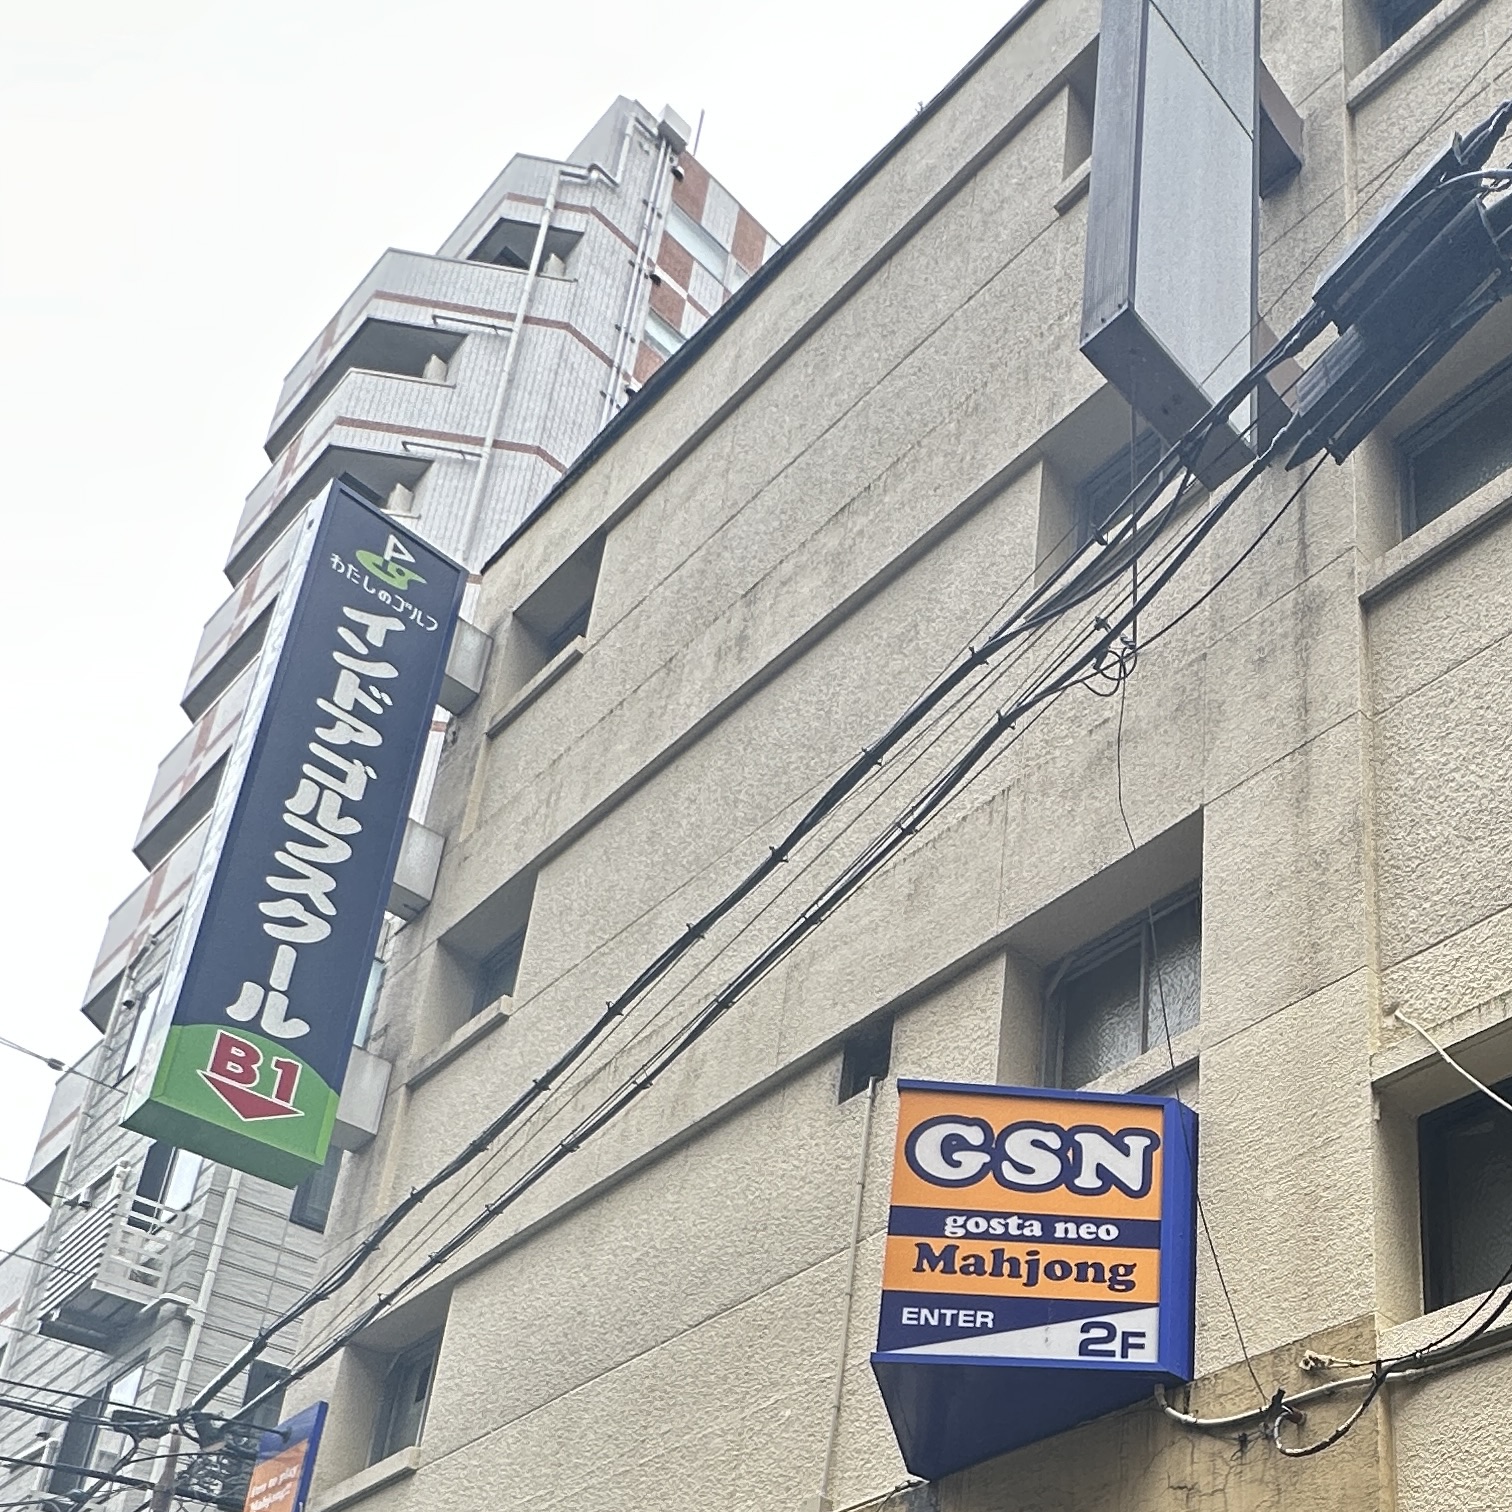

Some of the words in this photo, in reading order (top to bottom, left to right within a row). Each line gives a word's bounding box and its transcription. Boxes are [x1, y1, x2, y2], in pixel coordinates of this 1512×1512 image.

[330, 554, 439, 631] わたしのゴルフ
[226, 605, 406, 1039] インドアゴルフスクール
[206, 1029, 302, 1106] B1
[908, 1117, 1158, 1197] GSN
[944, 1215, 1042, 1238] gosta
[1054, 1220, 1119, 1241] neo
[912, 1242, 1137, 1293] Mahjong
[901, 1307, 994, 1328] ENTER
[1078, 1321, 1146, 1359] 2F
